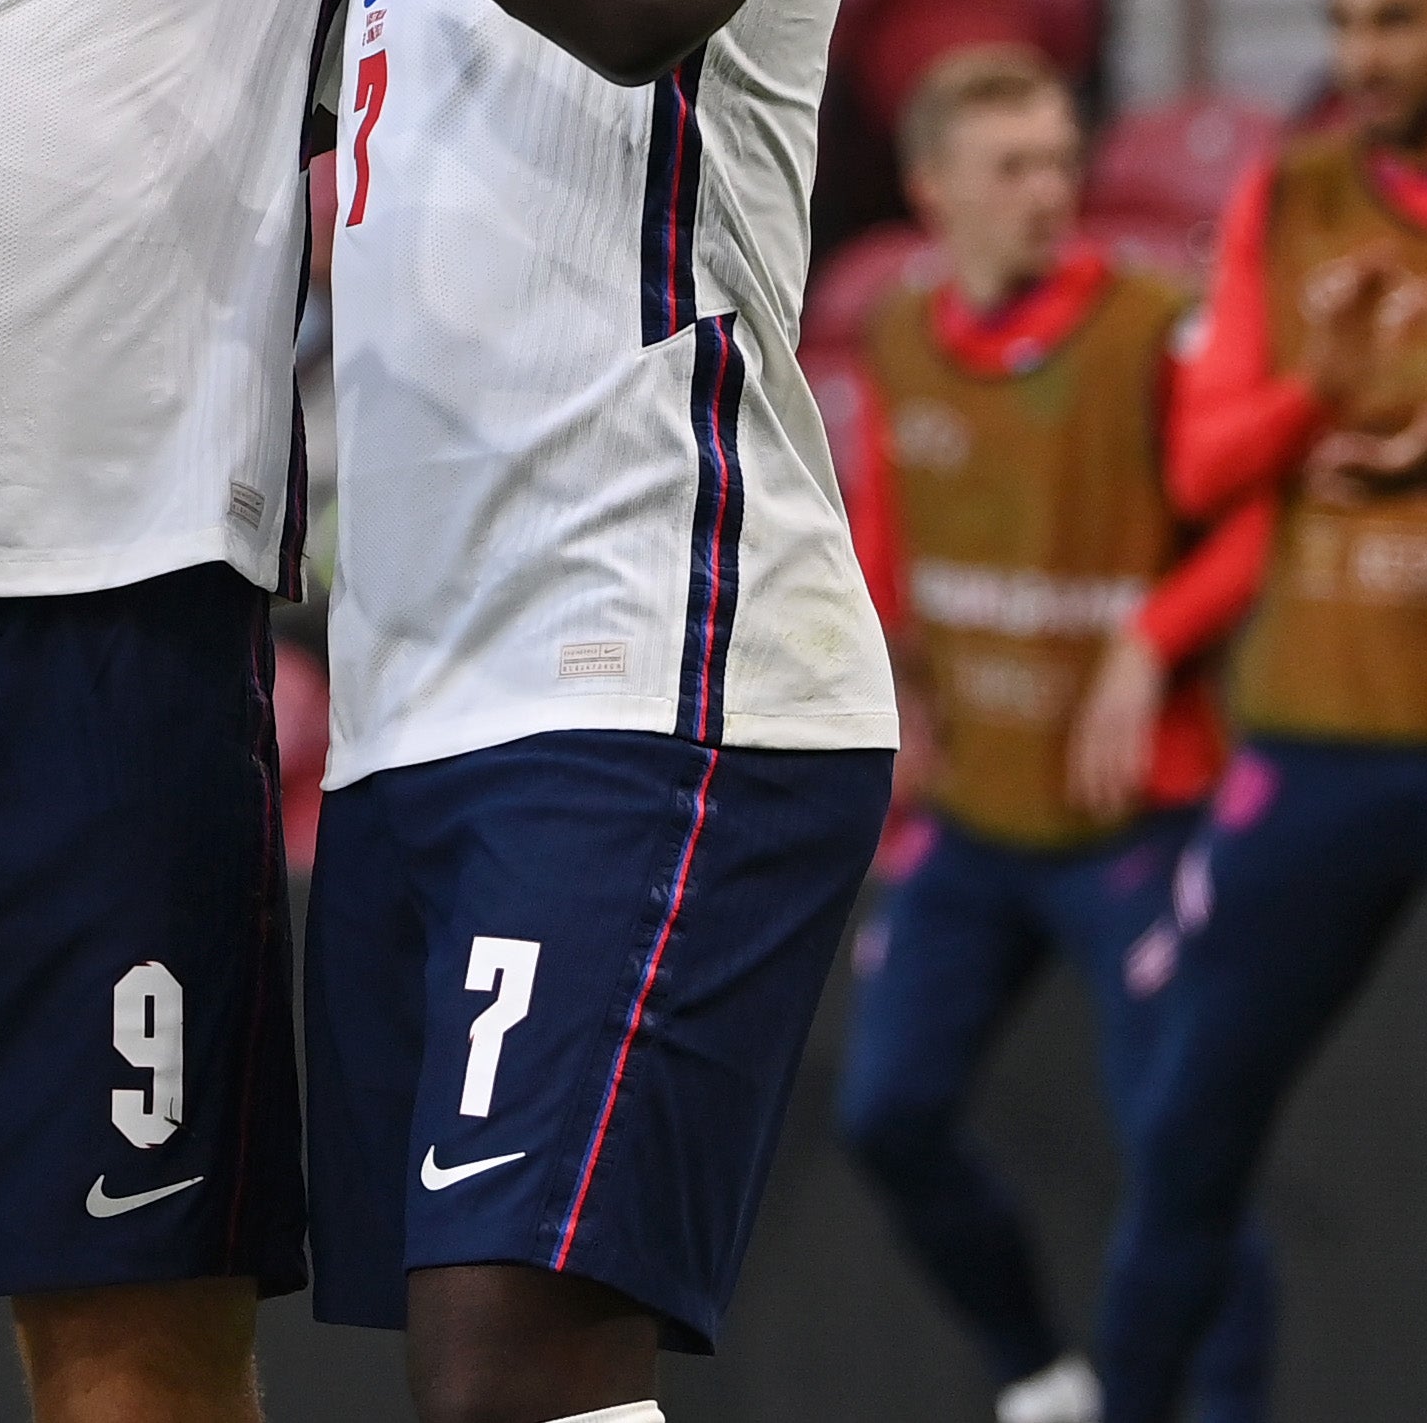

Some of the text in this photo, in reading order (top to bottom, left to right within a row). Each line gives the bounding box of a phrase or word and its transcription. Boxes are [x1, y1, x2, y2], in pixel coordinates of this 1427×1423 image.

[346, 48, 387, 227] 7
[111, 960, 184, 1149] 9
[458, 936, 542, 1118] 7
